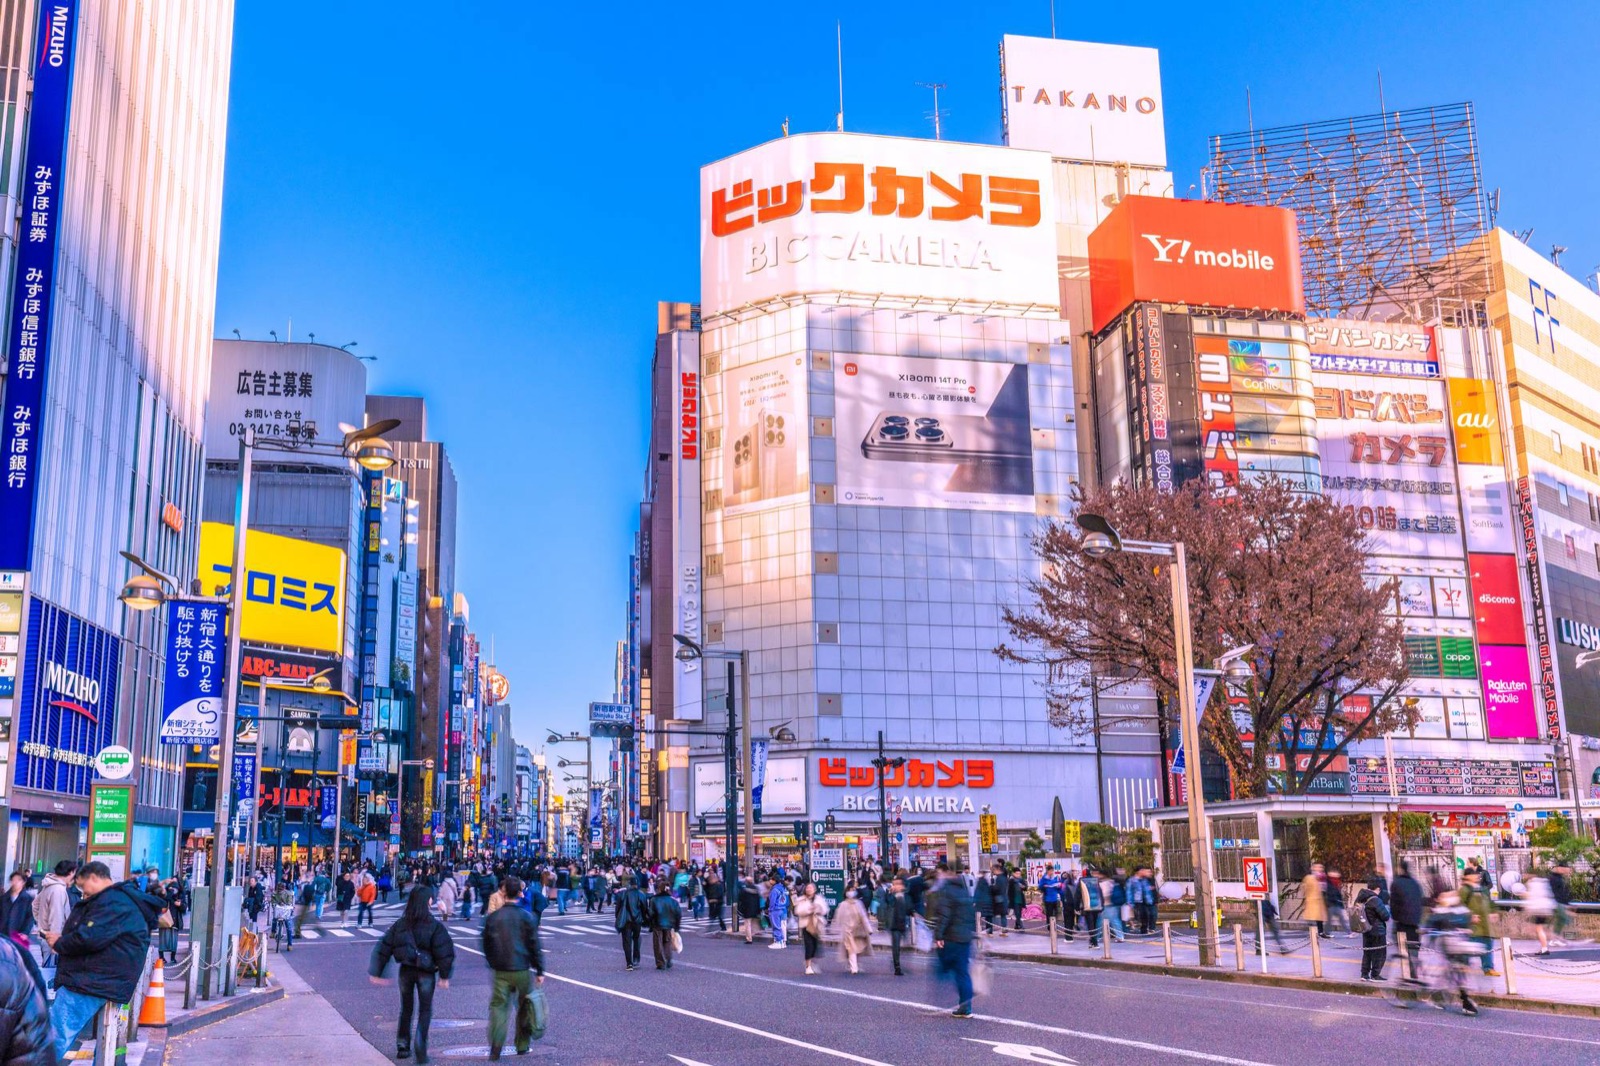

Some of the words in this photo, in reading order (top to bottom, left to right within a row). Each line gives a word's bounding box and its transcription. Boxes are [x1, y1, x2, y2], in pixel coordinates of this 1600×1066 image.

[49, 6, 69, 68] MIZUHO
[1012, 85, 1156, 114] TAKANO
[29, 166, 52, 243] みずほ証券
[712, 161, 1041, 238] ビックカメラ
[746, 236, 809, 275] BIC
[822, 231, 1003, 272] CAMERA
[17, 267, 43, 380] みずほ信託銀行
[1147, 308, 1162, 379] ヨドバシカメラ
[1307, 326, 1431, 353] ドバシカメラ
[237, 370, 313, 398] 広告主募集
[939, 376, 952, 384] 14T
[953, 377, 967, 385] Pro
[244, 408, 303, 420] お問い合わせ
[682, 373, 698, 460] ビックカメラ
[1313, 387, 1444, 424] ヨドバシ
[1456, 412, 1495, 428] au
[7, 404, 32, 489] みずほ銀行
[1349, 431, 1448, 467] カメラ
[1472, 519, 1505, 529] SoftBank
[1517, 477, 1538, 565] ヨドバシカメラ
[684, 566, 698, 593] BIC
[1440, 588, 1461, 601] Y!
[1479, 594, 1516, 604] docomo
[174, 606, 196, 678] 駆け抜ける
[684, 600, 698, 674] CAMA
[1558, 619, 1600, 651] LUSH
[198, 608, 218, 693] 新宿大通りを
[1445, 653, 1471, 661] oppo
[241, 655, 316, 679] ABC-MART
[46, 661, 99, 705] MIZUHO
[1487, 679, 1528, 693] Rakuten
[1538, 644, 1560, 738] ヨドバシカメラ
[1489, 692, 1519, 704] Mobile
[166, 728, 218, 736] ハーフマラソン
[167, 719, 203, 728] 新宿シティ
[22, 741, 51, 759] みずほ銀行
[165, 736, 215, 745] 新宿大通商店街
[819, 757, 995, 788] ビックカメラ
[1303, 778, 1345, 789] oftBank
[259, 783, 321, 808] C-MART
[843, 795, 877, 811] BIC
